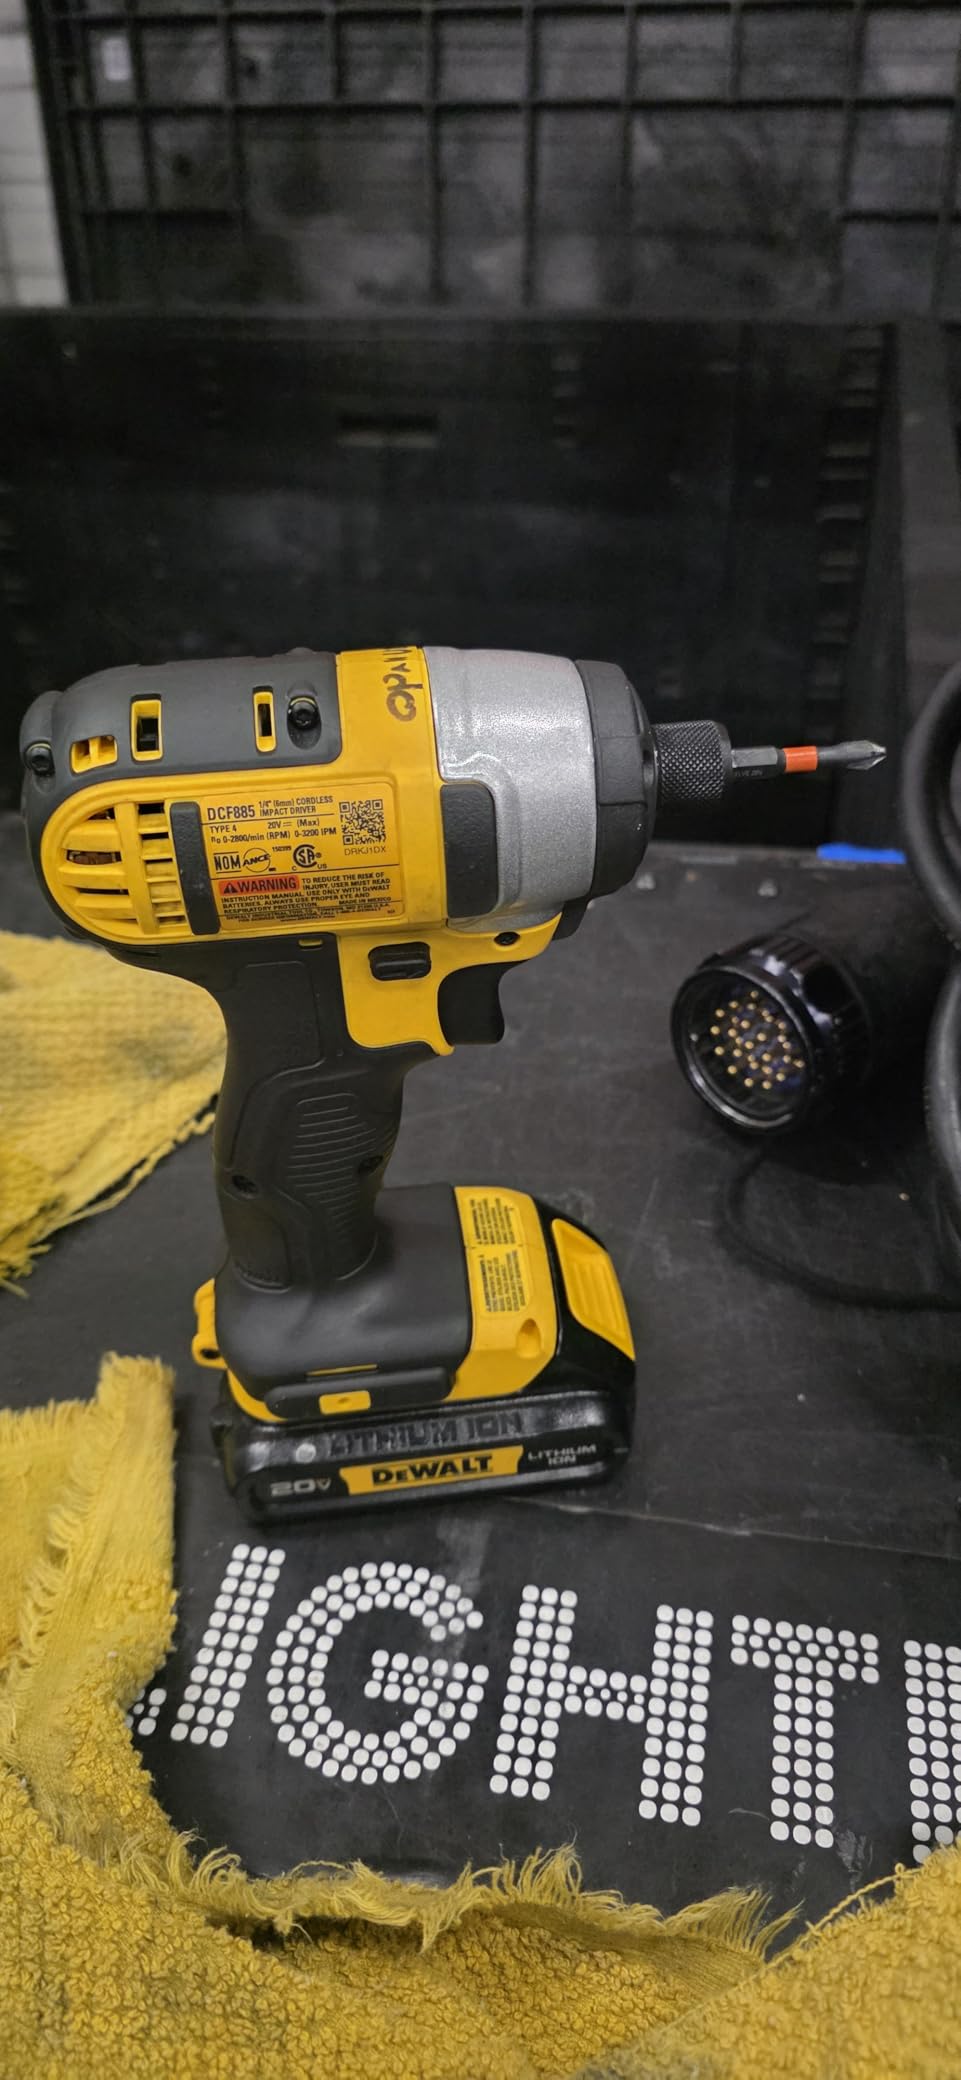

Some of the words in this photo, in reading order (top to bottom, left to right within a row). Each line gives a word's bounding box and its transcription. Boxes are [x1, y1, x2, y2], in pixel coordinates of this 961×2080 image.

[273, 798, 295, 808] (6mm)
[296, 796, 334, 805] CORDLESS
[207, 804, 256, 821] DCF885
[259, 808, 288, 817] IMPACT
[290, 806, 317, 814] DRIVER
[210, 824, 232, 834] TYPE
[232, 824, 238, 833] 4
[267, 820, 281, 829] 20V
[296, 818, 320, 828] (Max)
[222, 832, 265, 844] 0-2800/min
[266, 830, 291, 840] (RPM)
[294, 828, 320, 838] 0-3200
[321, 827, 337, 836] IPM
[214, 854, 242, 872] NOM
[242, 853, 272, 868] ANCE
[238, 877, 297, 894] WARNING
[312, 875, 342, 884] REDUCE
[342, 874, 357, 882] THE
[358, 873, 376, 881] RISK
[331, 881, 349, 889] USER
[350, 880, 372, 888] MUST
[372, 878, 391, 886] READ
[221, 894, 270, 904] INSTRUCTION
[306, 890, 322, 898] USE
[322, 888, 343, 897] ONLY
[343, 887, 361, 895] WITH
[264, 898, 292, 907] ALWAYS
[294, 896, 309, 904] USE
[310, 894, 339, 903] PROPER
[355, 892, 370, 900] AND
[224, 906, 272, 914] RESPIRATORY
[331, 1418, 457, 1456] LITHIUM
[468, 1412, 524, 1440] ION
[528, 1443, 597, 1461] LITHIUM
[548, 1455, 577, 1466] ION
